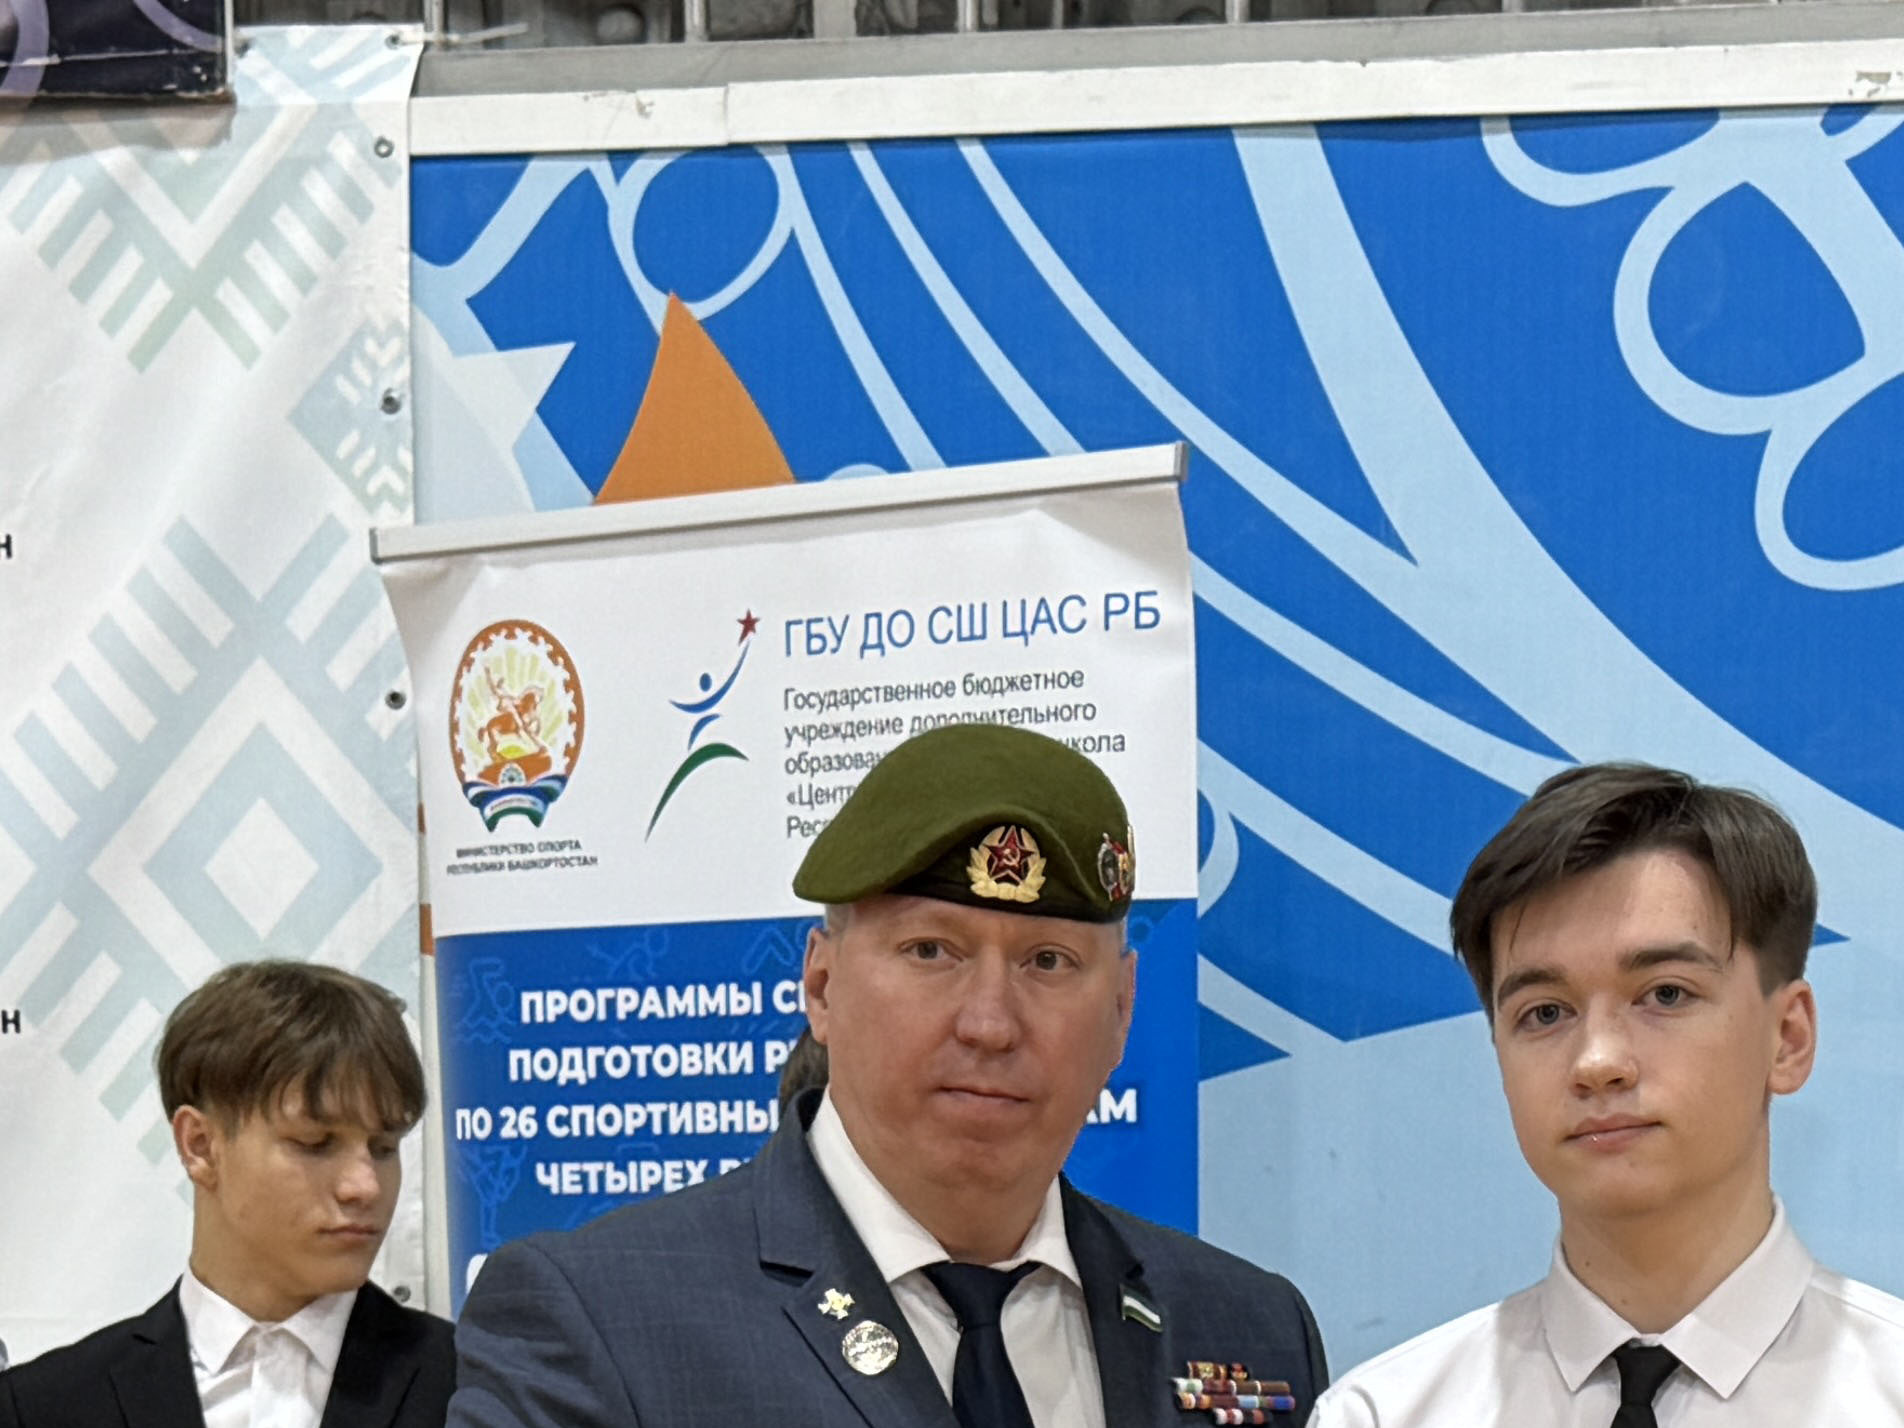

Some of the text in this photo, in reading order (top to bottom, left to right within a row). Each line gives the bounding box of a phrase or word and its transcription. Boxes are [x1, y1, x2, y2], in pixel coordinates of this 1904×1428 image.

[785, 590, 1161, 660] ГБУ ДО СШ ЦАС РБ
[783, 668, 1085, 714] Государственное бюджетное
[784, 716, 904, 748] учреждение
[784, 751, 883, 778] образова
[521, 982, 763, 1024] ПРОГРАММЫ
[509, 1041, 754, 1086] ПОДГОТОВКИ
[456, 1099, 781, 1140] ПО 26 СПОРТИВНЫ
[535, 1159, 707, 1195] ЧЕТЫРЕХ
